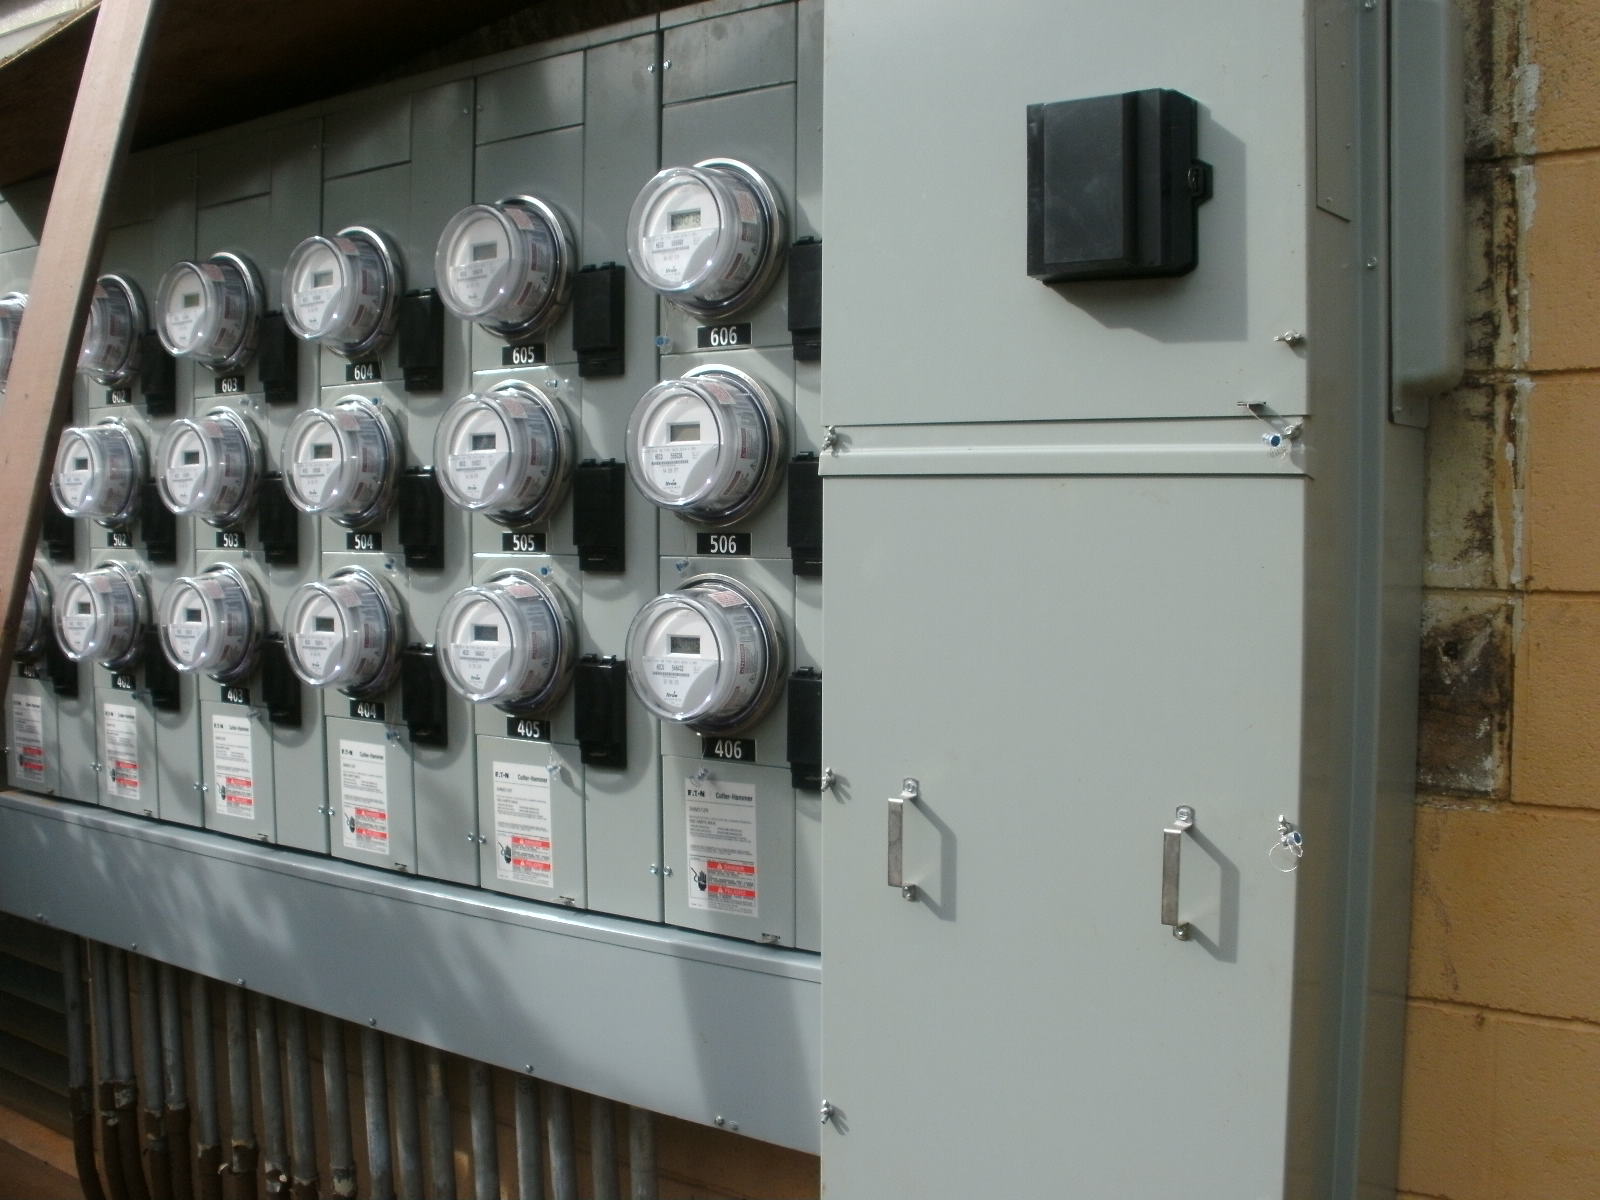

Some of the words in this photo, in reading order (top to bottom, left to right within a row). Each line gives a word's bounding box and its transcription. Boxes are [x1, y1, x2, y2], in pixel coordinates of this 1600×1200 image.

[710, 326, 738, 346] 606
[512, 346, 535, 364] 605
[354, 364, 374, 380] 604
[222, 378, 238, 393] 603
[223, 533, 239, 547] 503
[354, 534, 374, 549] 504
[512, 534, 535, 551] 505
[710, 535, 737, 554] 506
[227, 688, 244, 703] 403
[357, 702, 376, 719] 404
[517, 720, 540, 738] 405
[714, 739, 742, 759] 406
